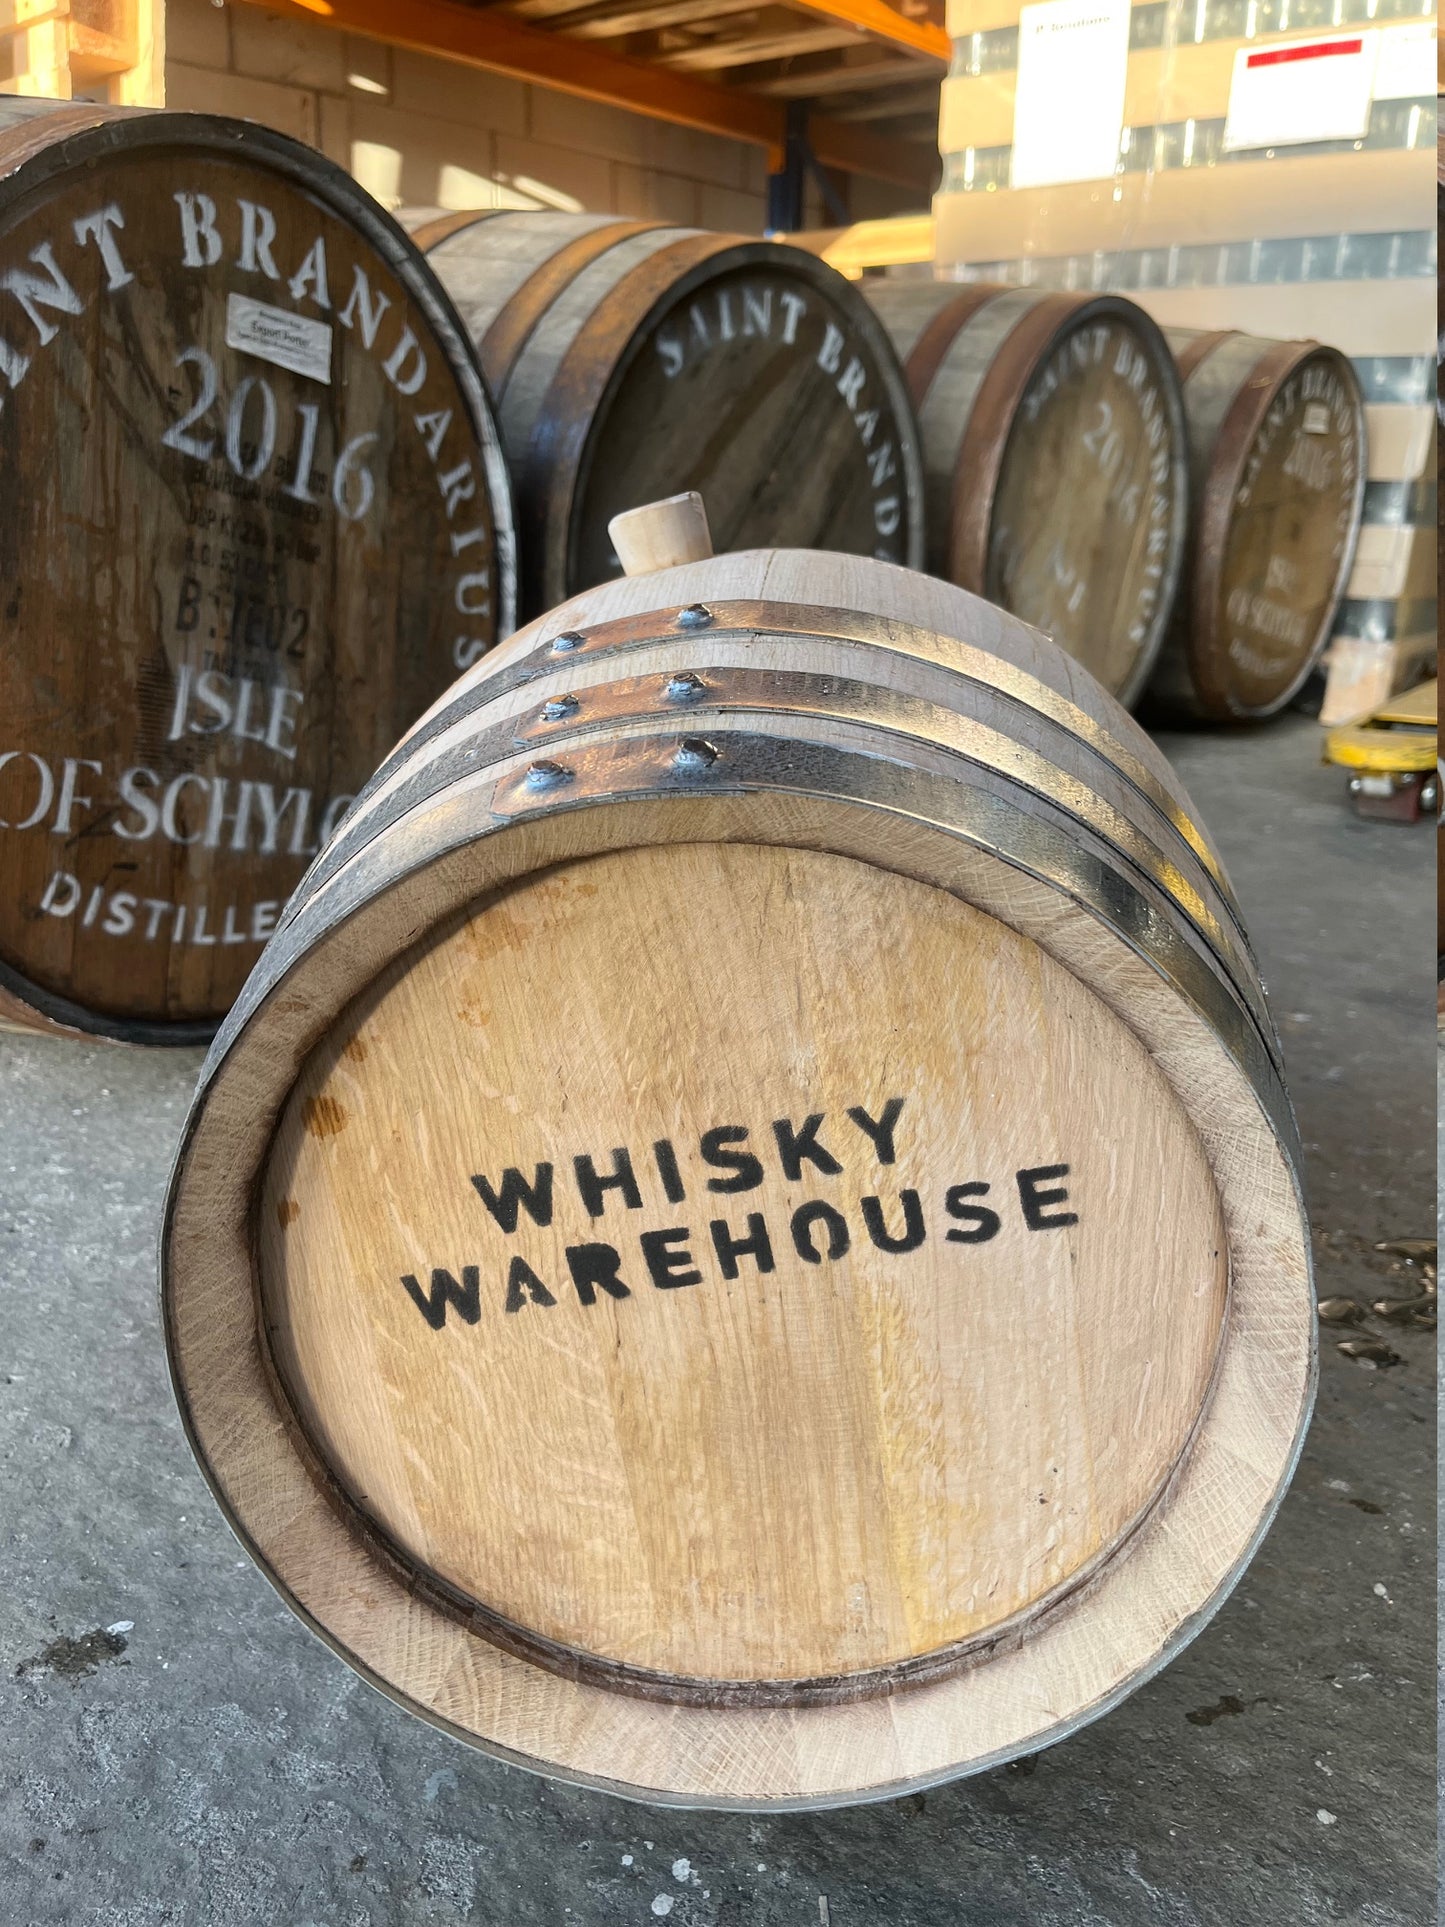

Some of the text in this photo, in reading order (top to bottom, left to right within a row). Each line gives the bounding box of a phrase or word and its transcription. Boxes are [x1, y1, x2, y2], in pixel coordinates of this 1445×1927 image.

[162, 351, 378, 520] 2016
[174, 192, 490, 669] BRANDARIUS
[168, 664, 304, 760] ISLE
[0, 751, 102, 833] OF
[470, 1097, 905, 1234] WHISKY
[400, 1163, 1079, 1332] WAREHOUSE
